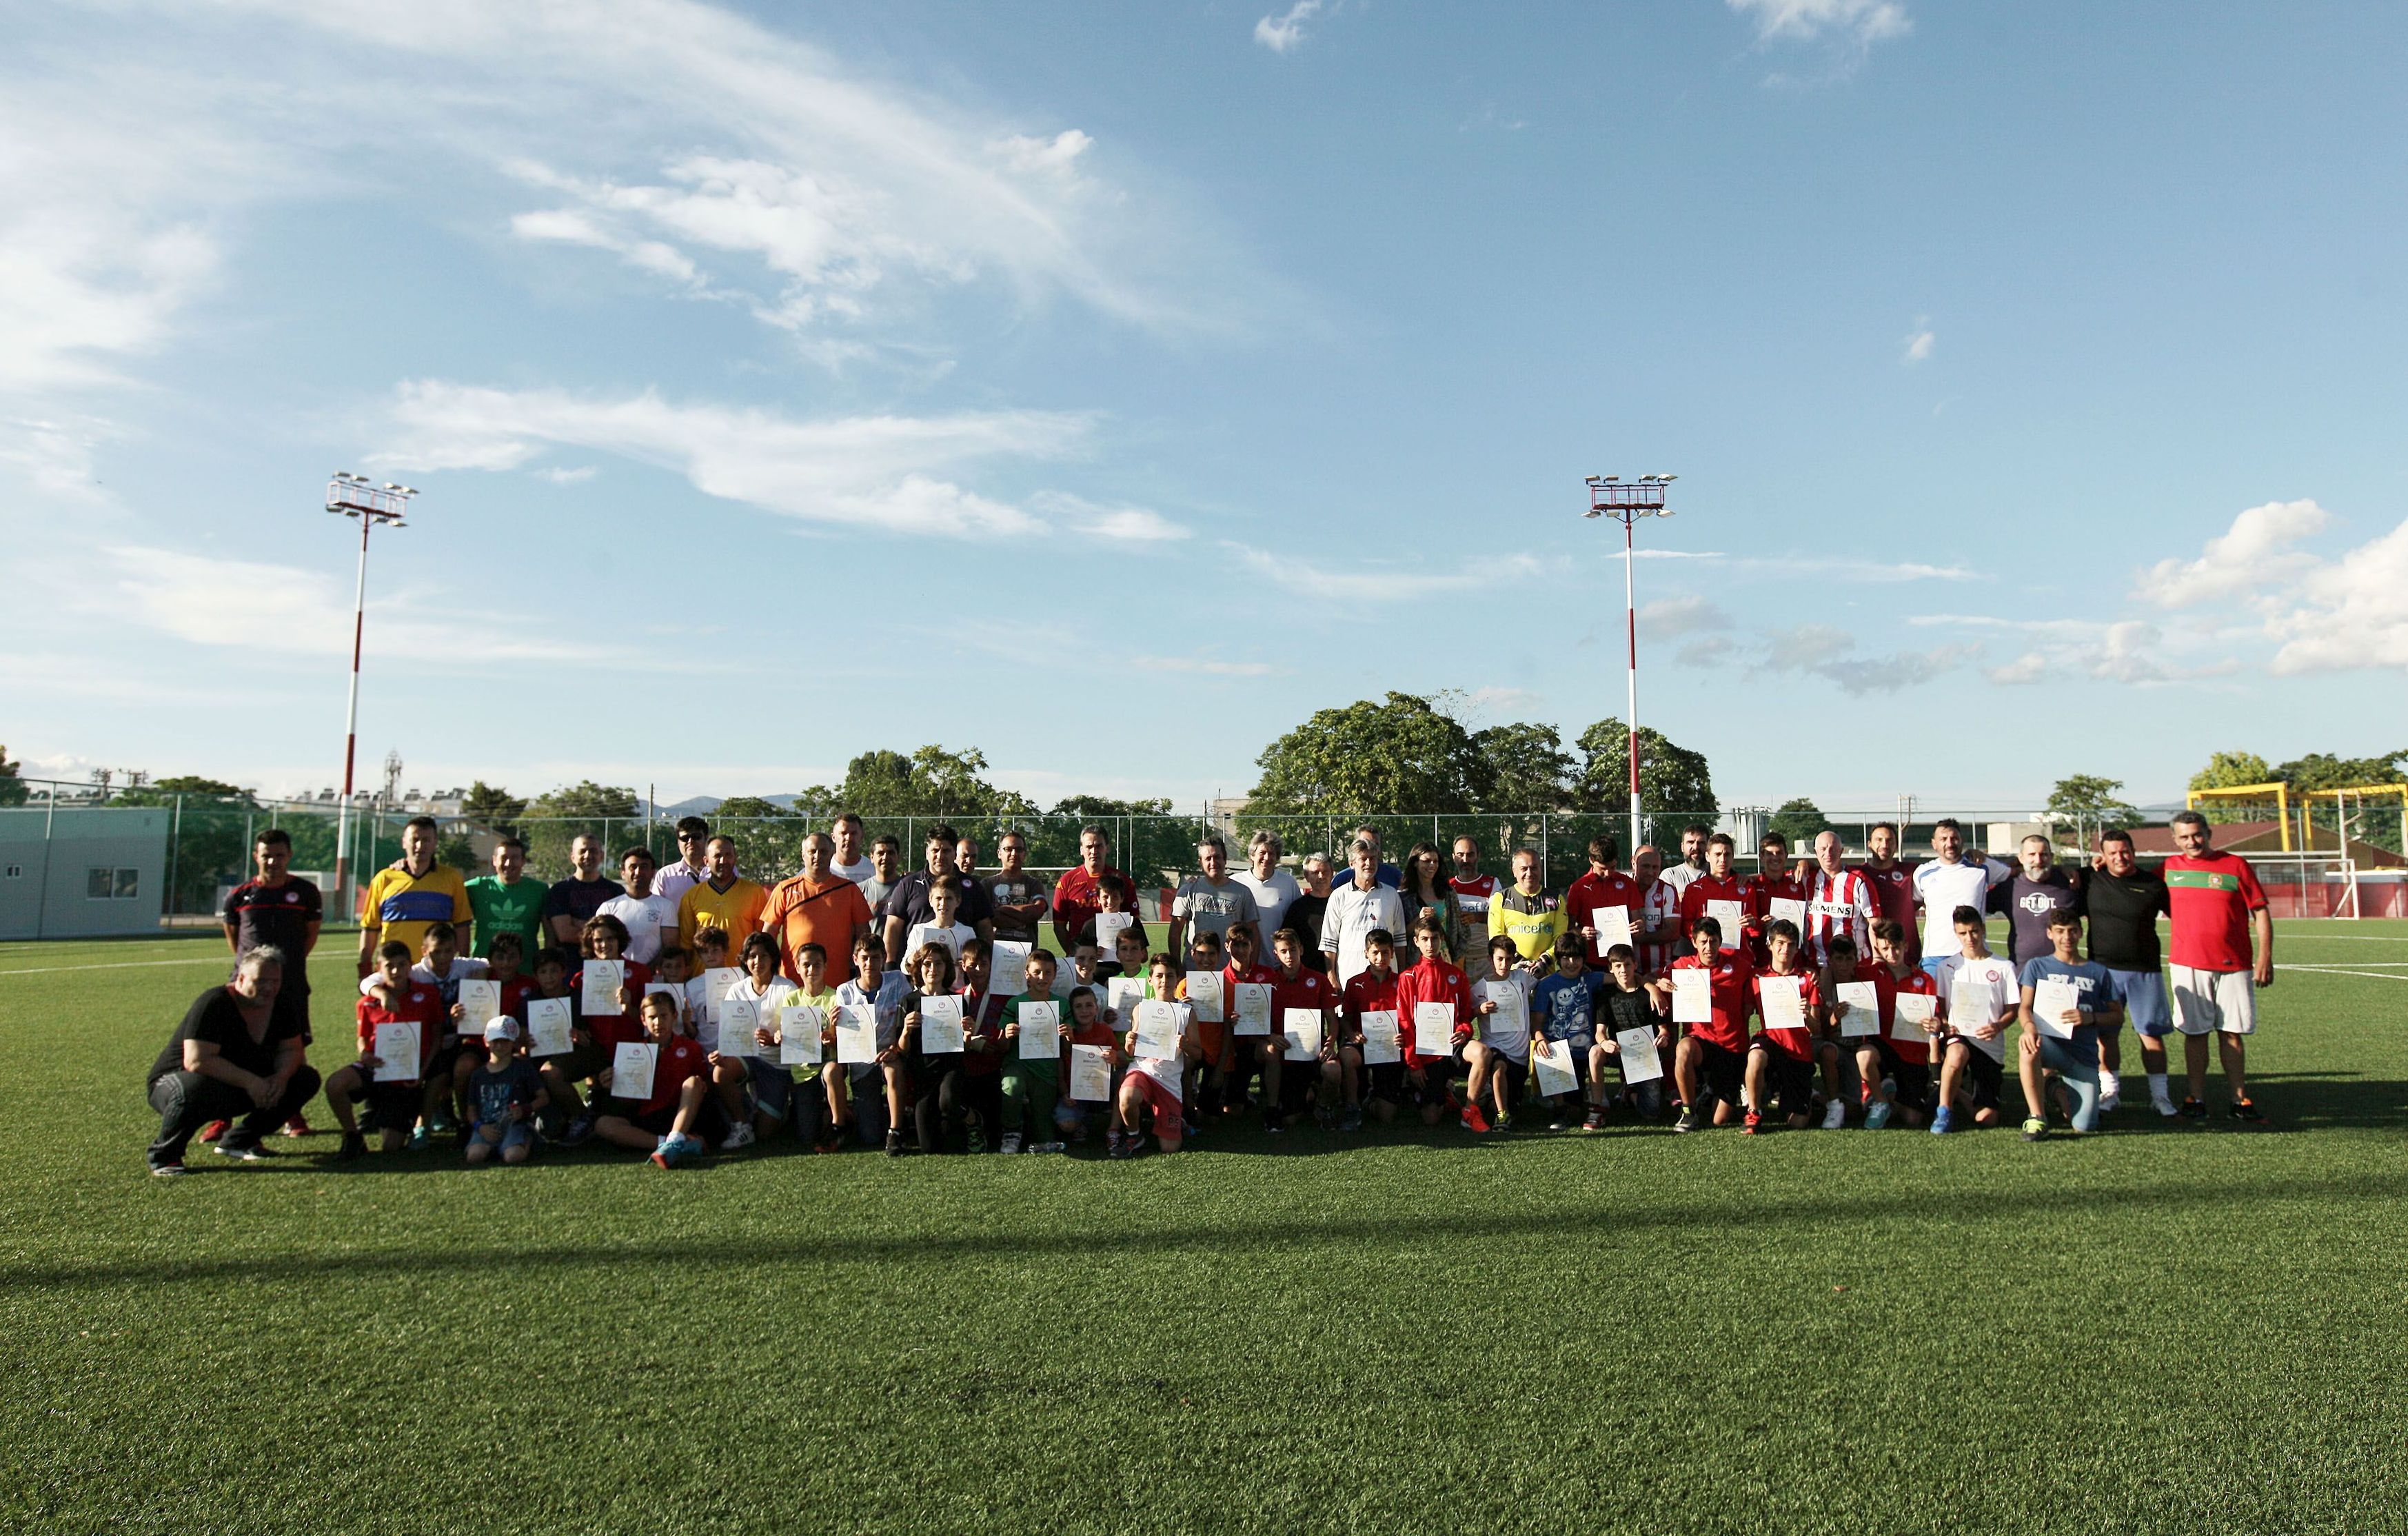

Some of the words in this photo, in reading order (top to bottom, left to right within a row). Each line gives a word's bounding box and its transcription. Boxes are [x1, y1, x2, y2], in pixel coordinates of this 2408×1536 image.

[2019, 897, 2036, 908] GET
[2038, 897, 2057, 909] OUT.
[1808, 902, 1851, 916] SIEMENS
[487, 920, 524, 931] adidas
[1506, 922, 1543, 933] unicef
